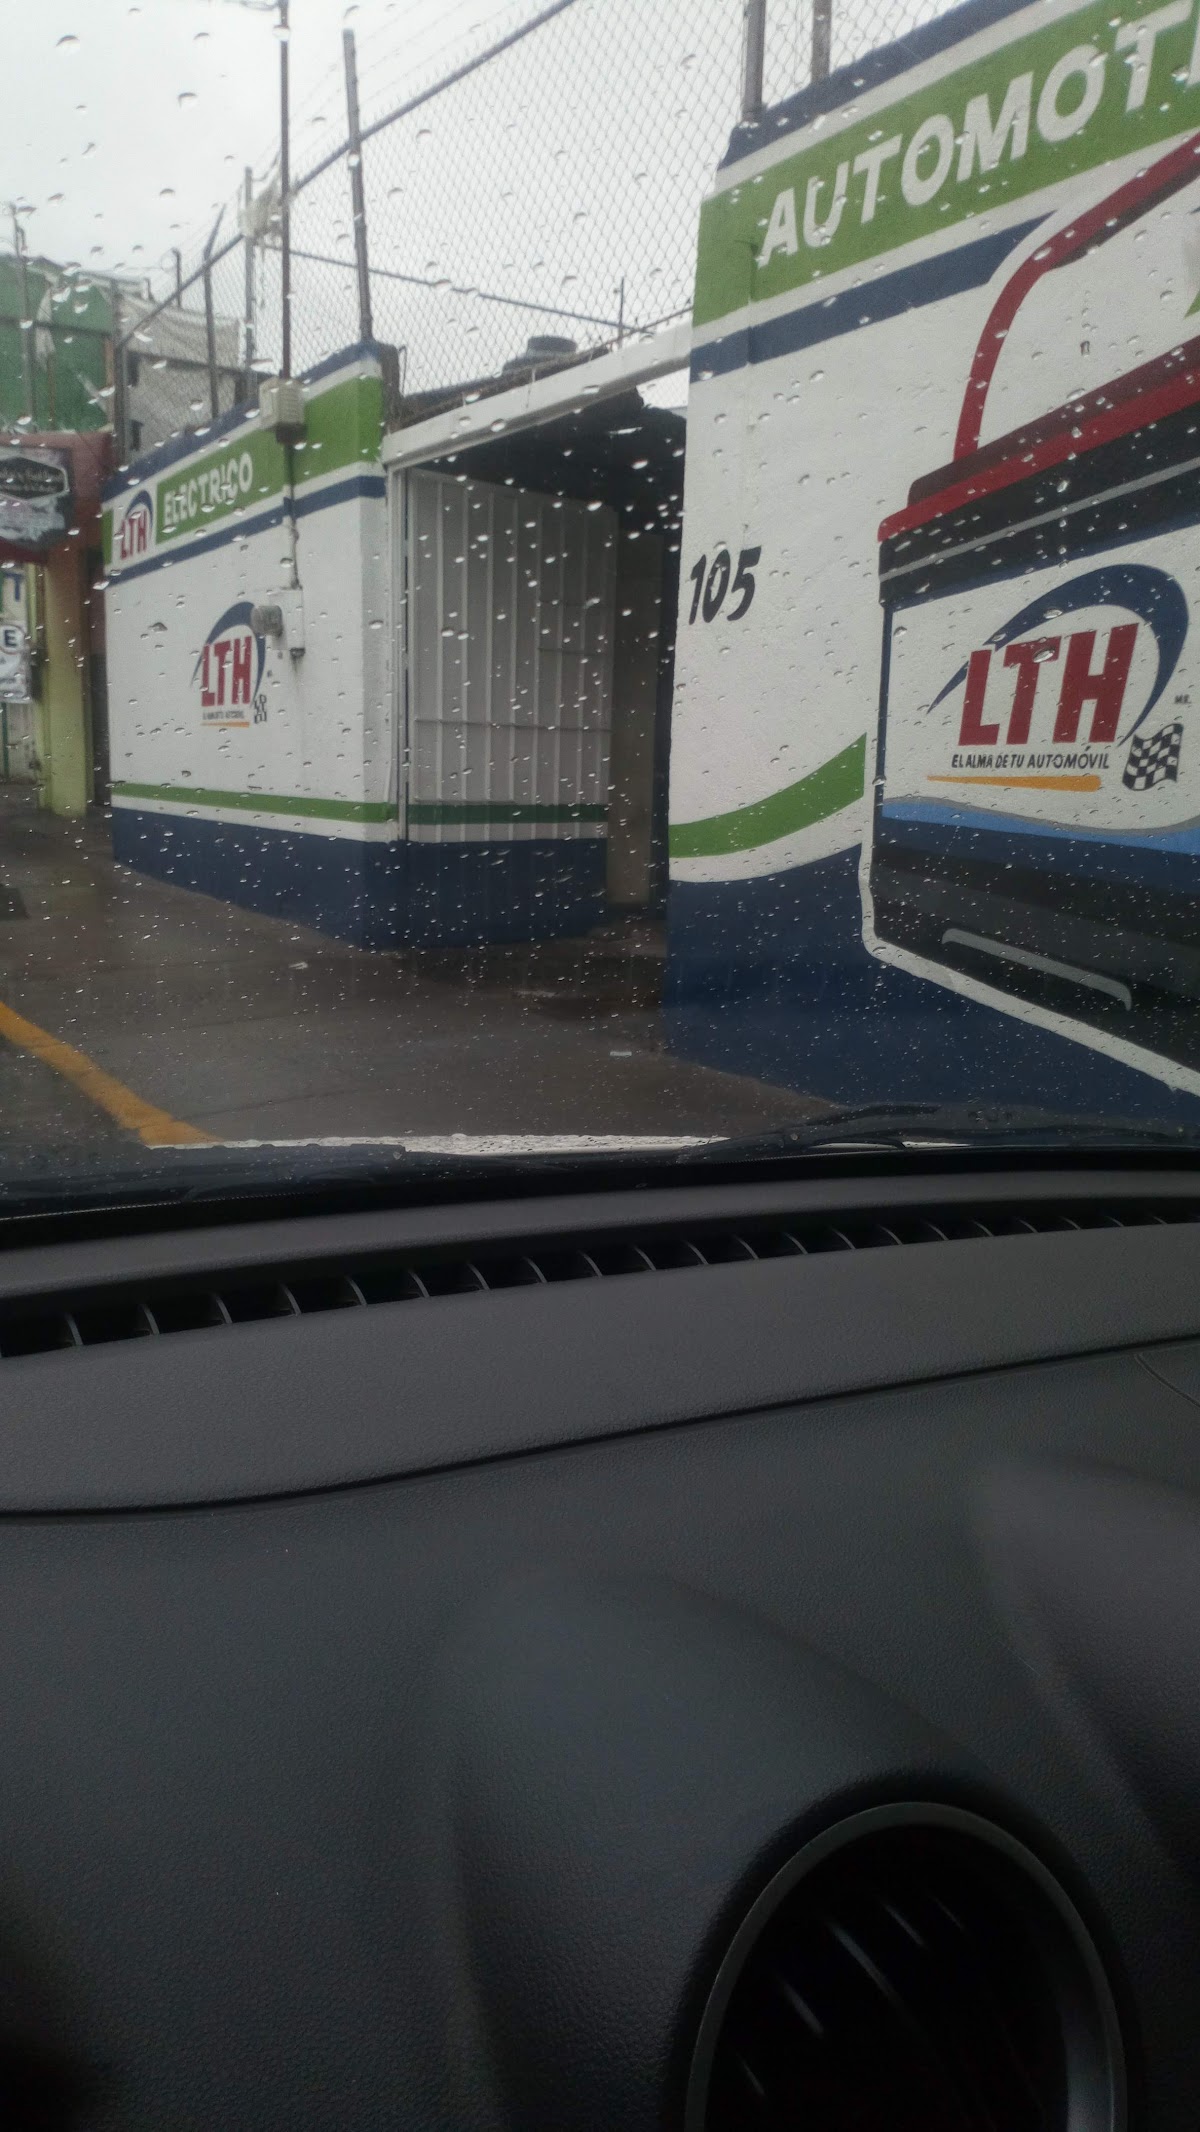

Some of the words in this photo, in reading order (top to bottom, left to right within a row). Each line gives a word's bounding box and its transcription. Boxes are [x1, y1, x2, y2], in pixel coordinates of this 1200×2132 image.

[120, 508, 148, 560] LTH
[688, 545, 762, 625] 105
[201, 635, 252, 707] LTH
[958, 623, 1139, 746] LTH
[951, 754, 963, 768] EL
[965, 754, 992, 768] ALMA
[994, 754, 1007, 768] DE
[1010, 754, 1025, 768] TU
[1026, 745, 1110, 769] AUTOMÓVIL
